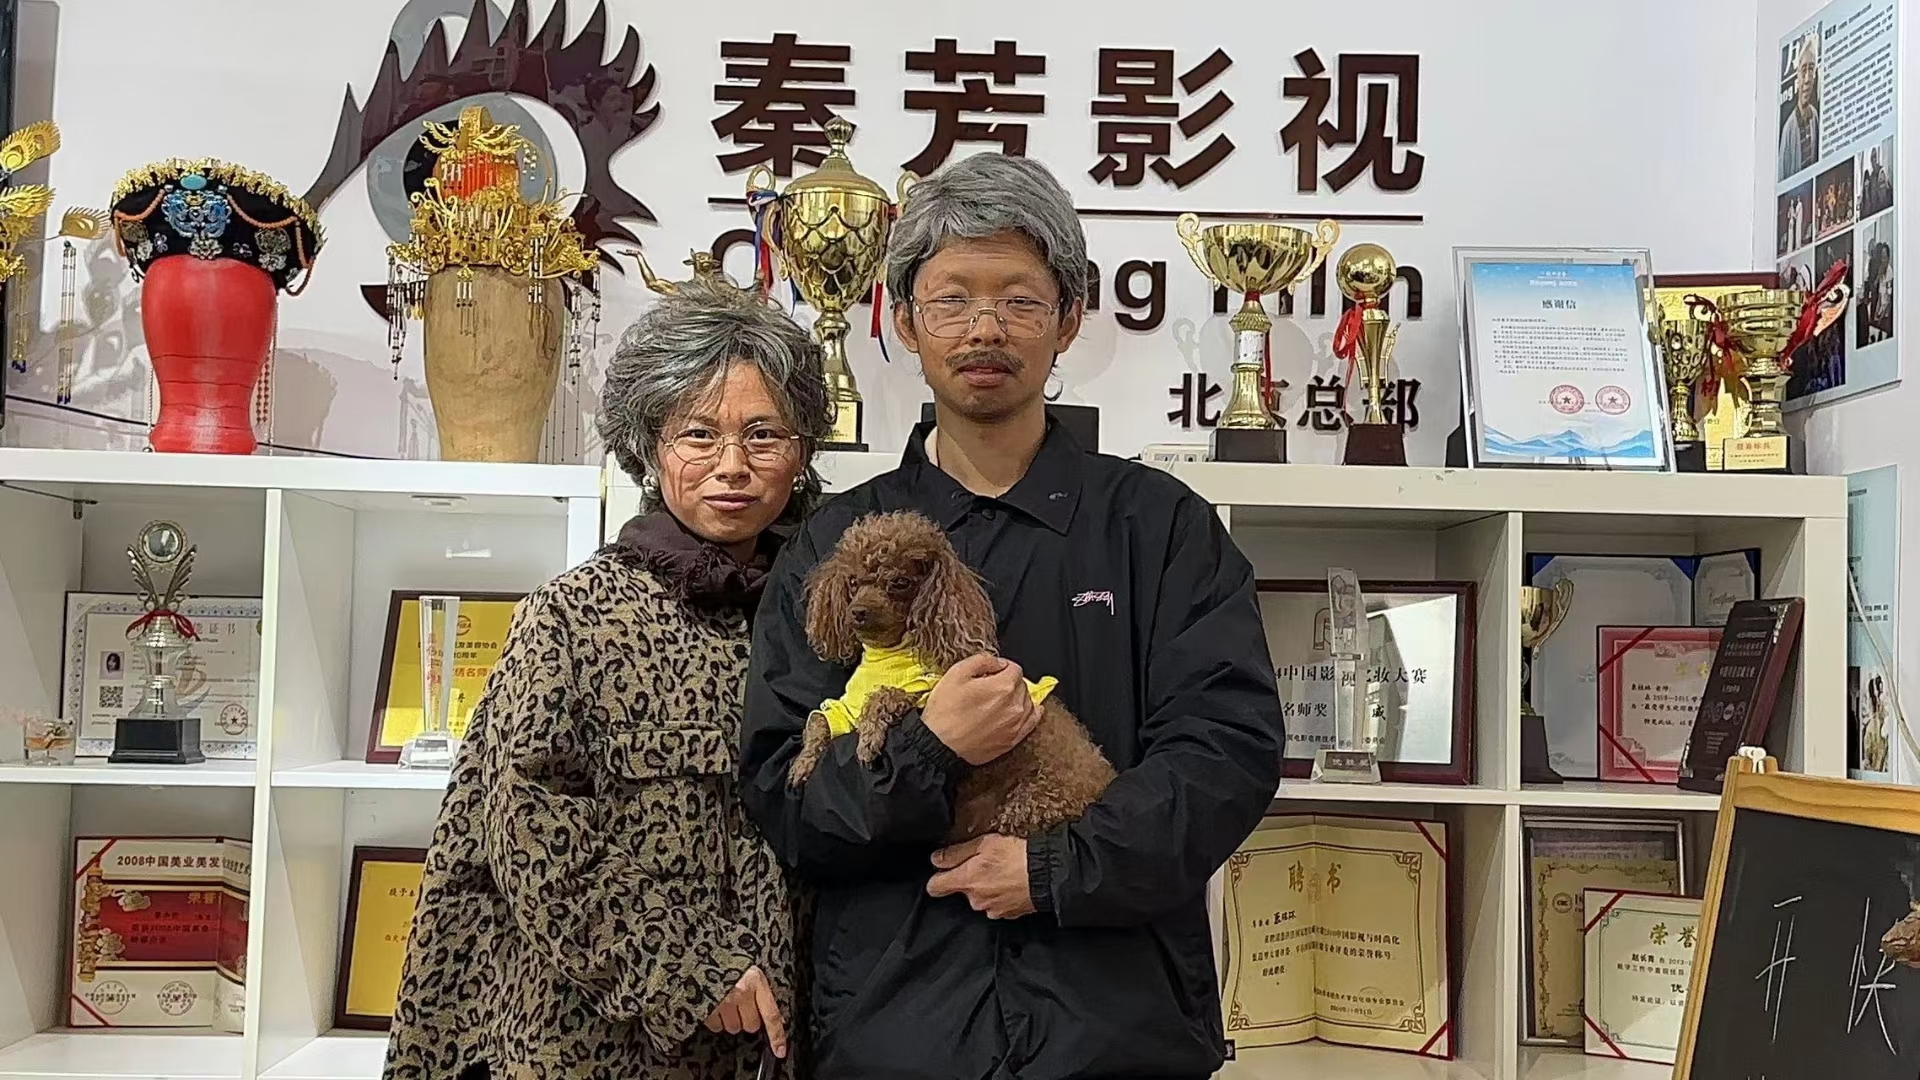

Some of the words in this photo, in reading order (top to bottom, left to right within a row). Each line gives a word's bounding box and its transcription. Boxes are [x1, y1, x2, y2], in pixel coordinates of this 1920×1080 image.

[712, 33, 1424, 193] 秦芳影视
[1542, 299, 1576, 309] 感谢信
[1649, 922, 1698, 949] 荣誉
